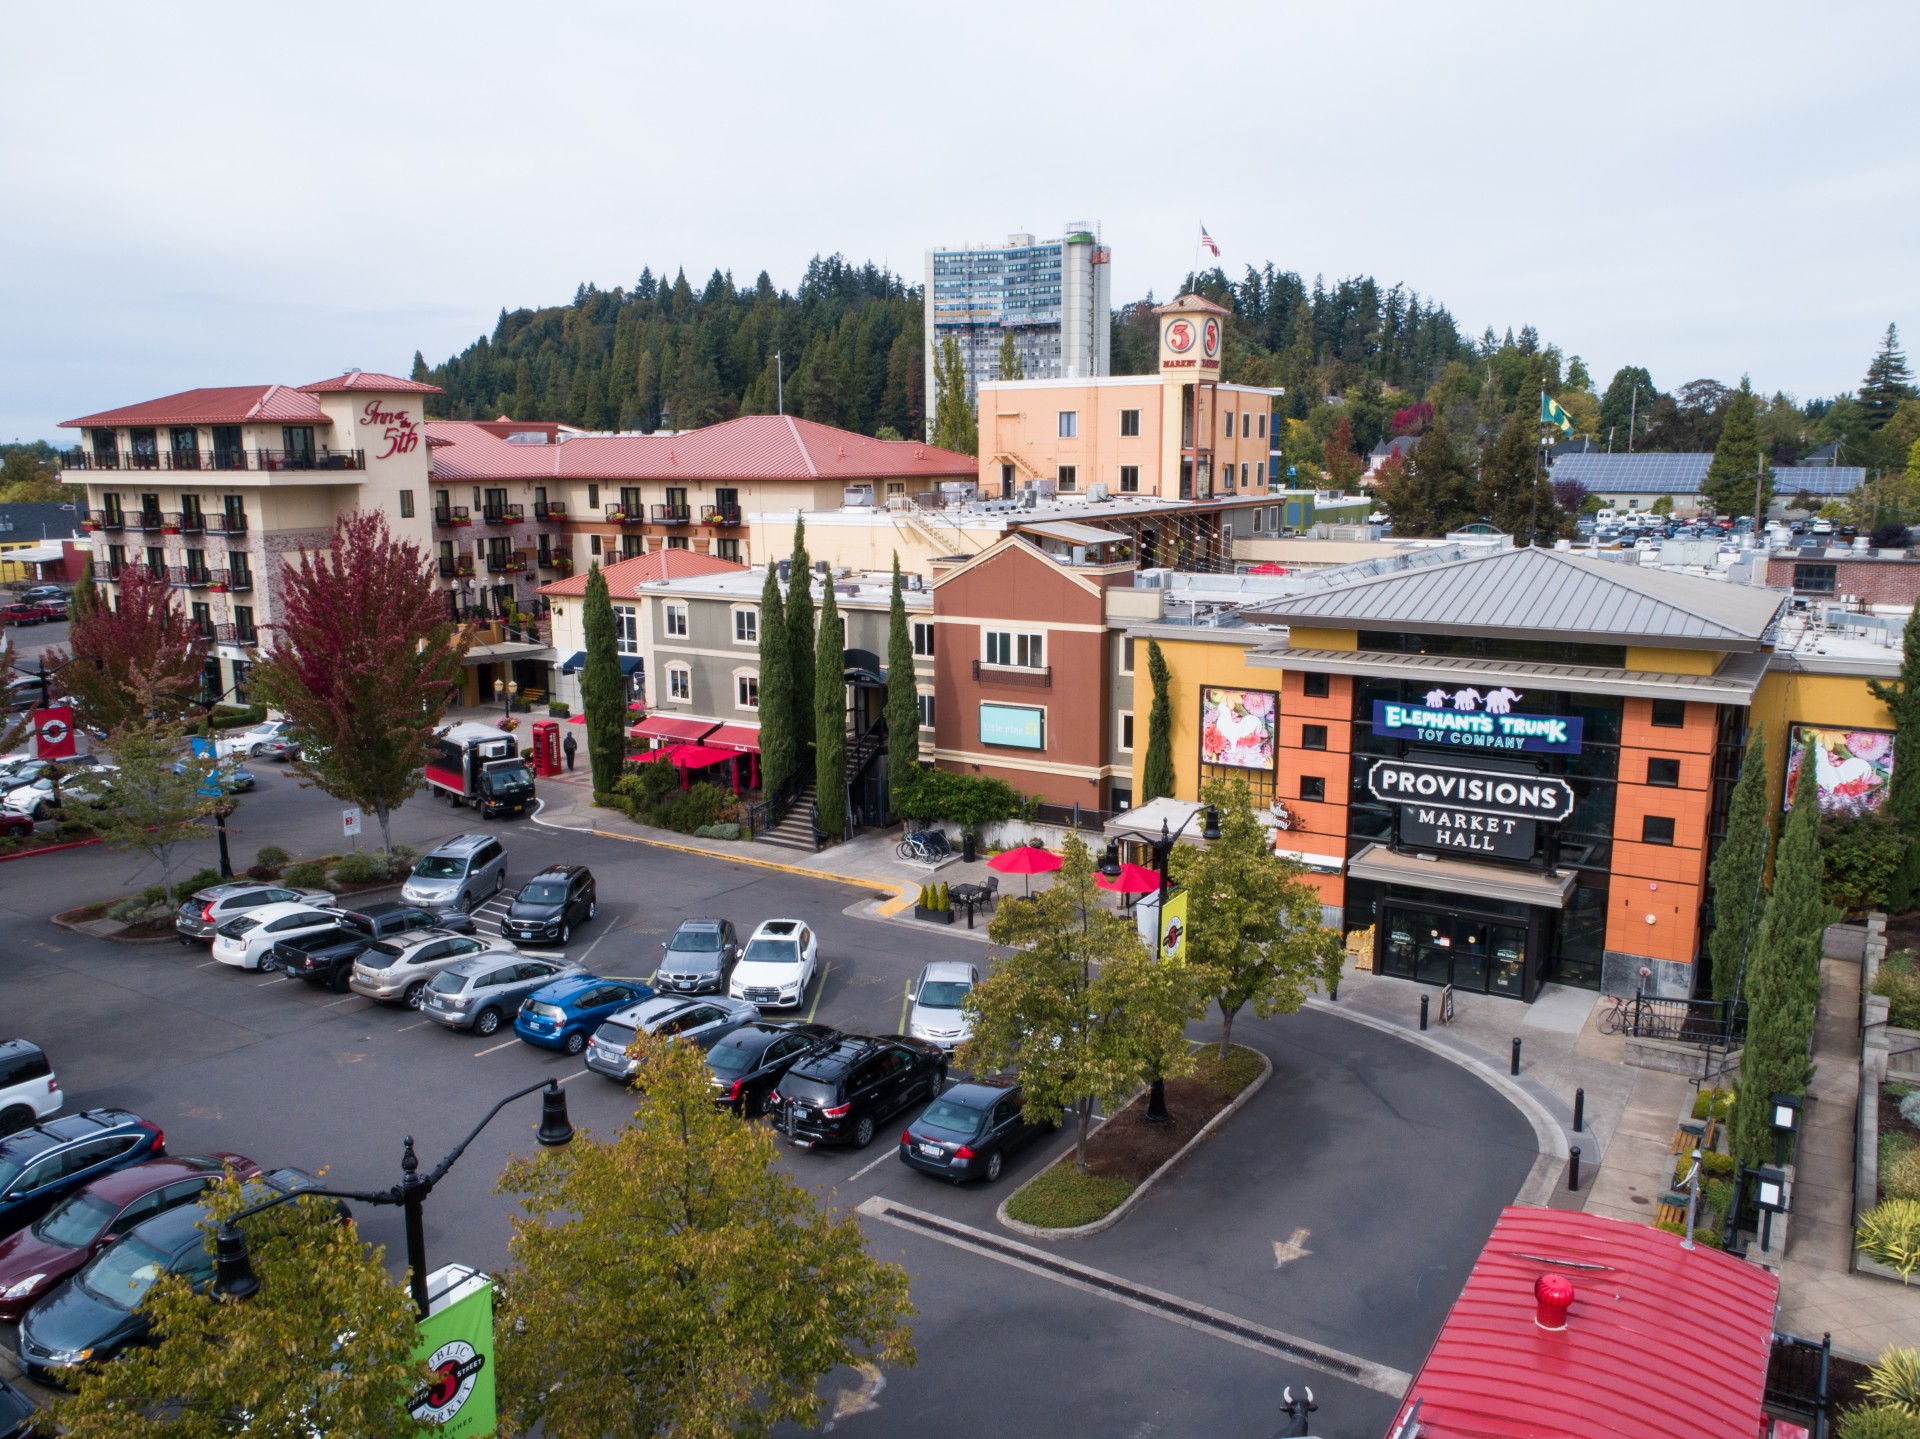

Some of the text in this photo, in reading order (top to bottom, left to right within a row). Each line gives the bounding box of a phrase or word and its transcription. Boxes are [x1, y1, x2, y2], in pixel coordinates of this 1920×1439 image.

[1171, 324, 1190, 350] 5
[1163, 360, 1196, 368] MARKET
[360, 400, 394, 425] Inn
[376, 422, 419, 459] 5th
[1385, 704, 1567, 743] ELEPHANT'S TRUNK
[1418, 729, 1525, 749] TOY COMPANY
[1382, 770, 1557, 809] PROVISIONS
[1419, 809, 1516, 834] MARKET
[1436, 830, 1495, 850] HALL
[457, 1358, 482, 1377] STREET
